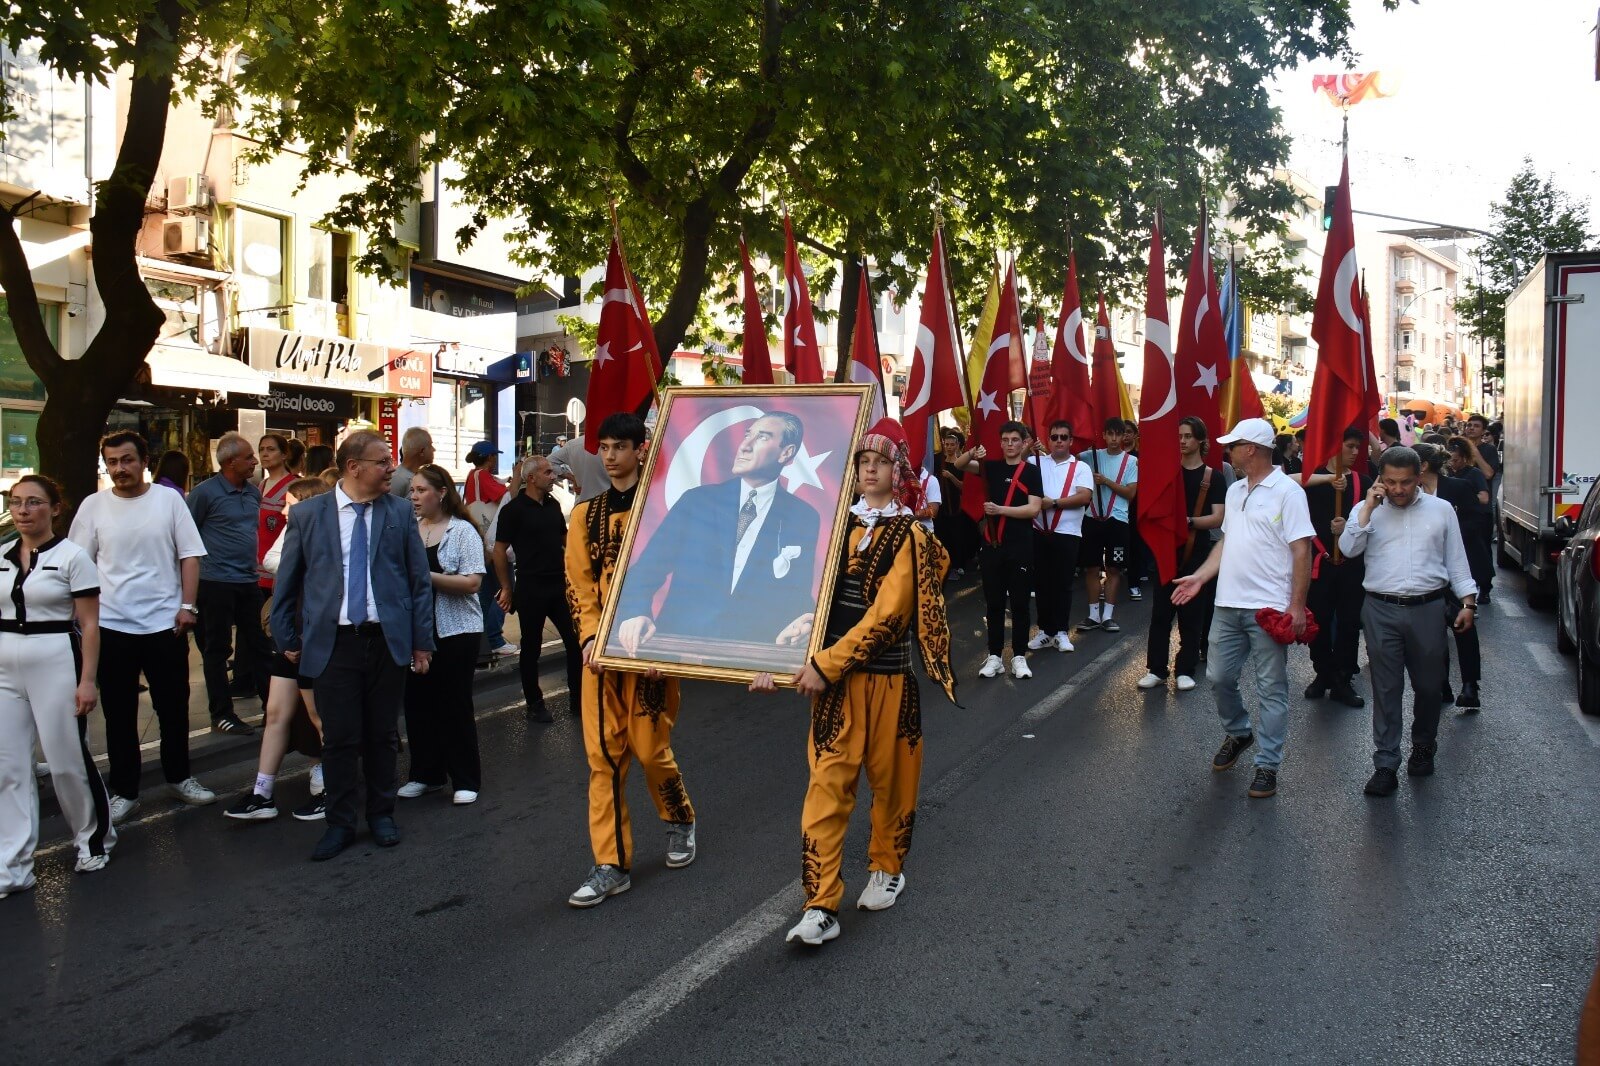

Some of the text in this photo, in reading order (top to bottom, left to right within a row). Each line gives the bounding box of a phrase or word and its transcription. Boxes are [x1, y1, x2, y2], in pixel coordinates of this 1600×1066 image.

[452, 306, 464, 317] EV
[400, 375, 421, 390] CAM
[381, 401, 396, 418] CAM
